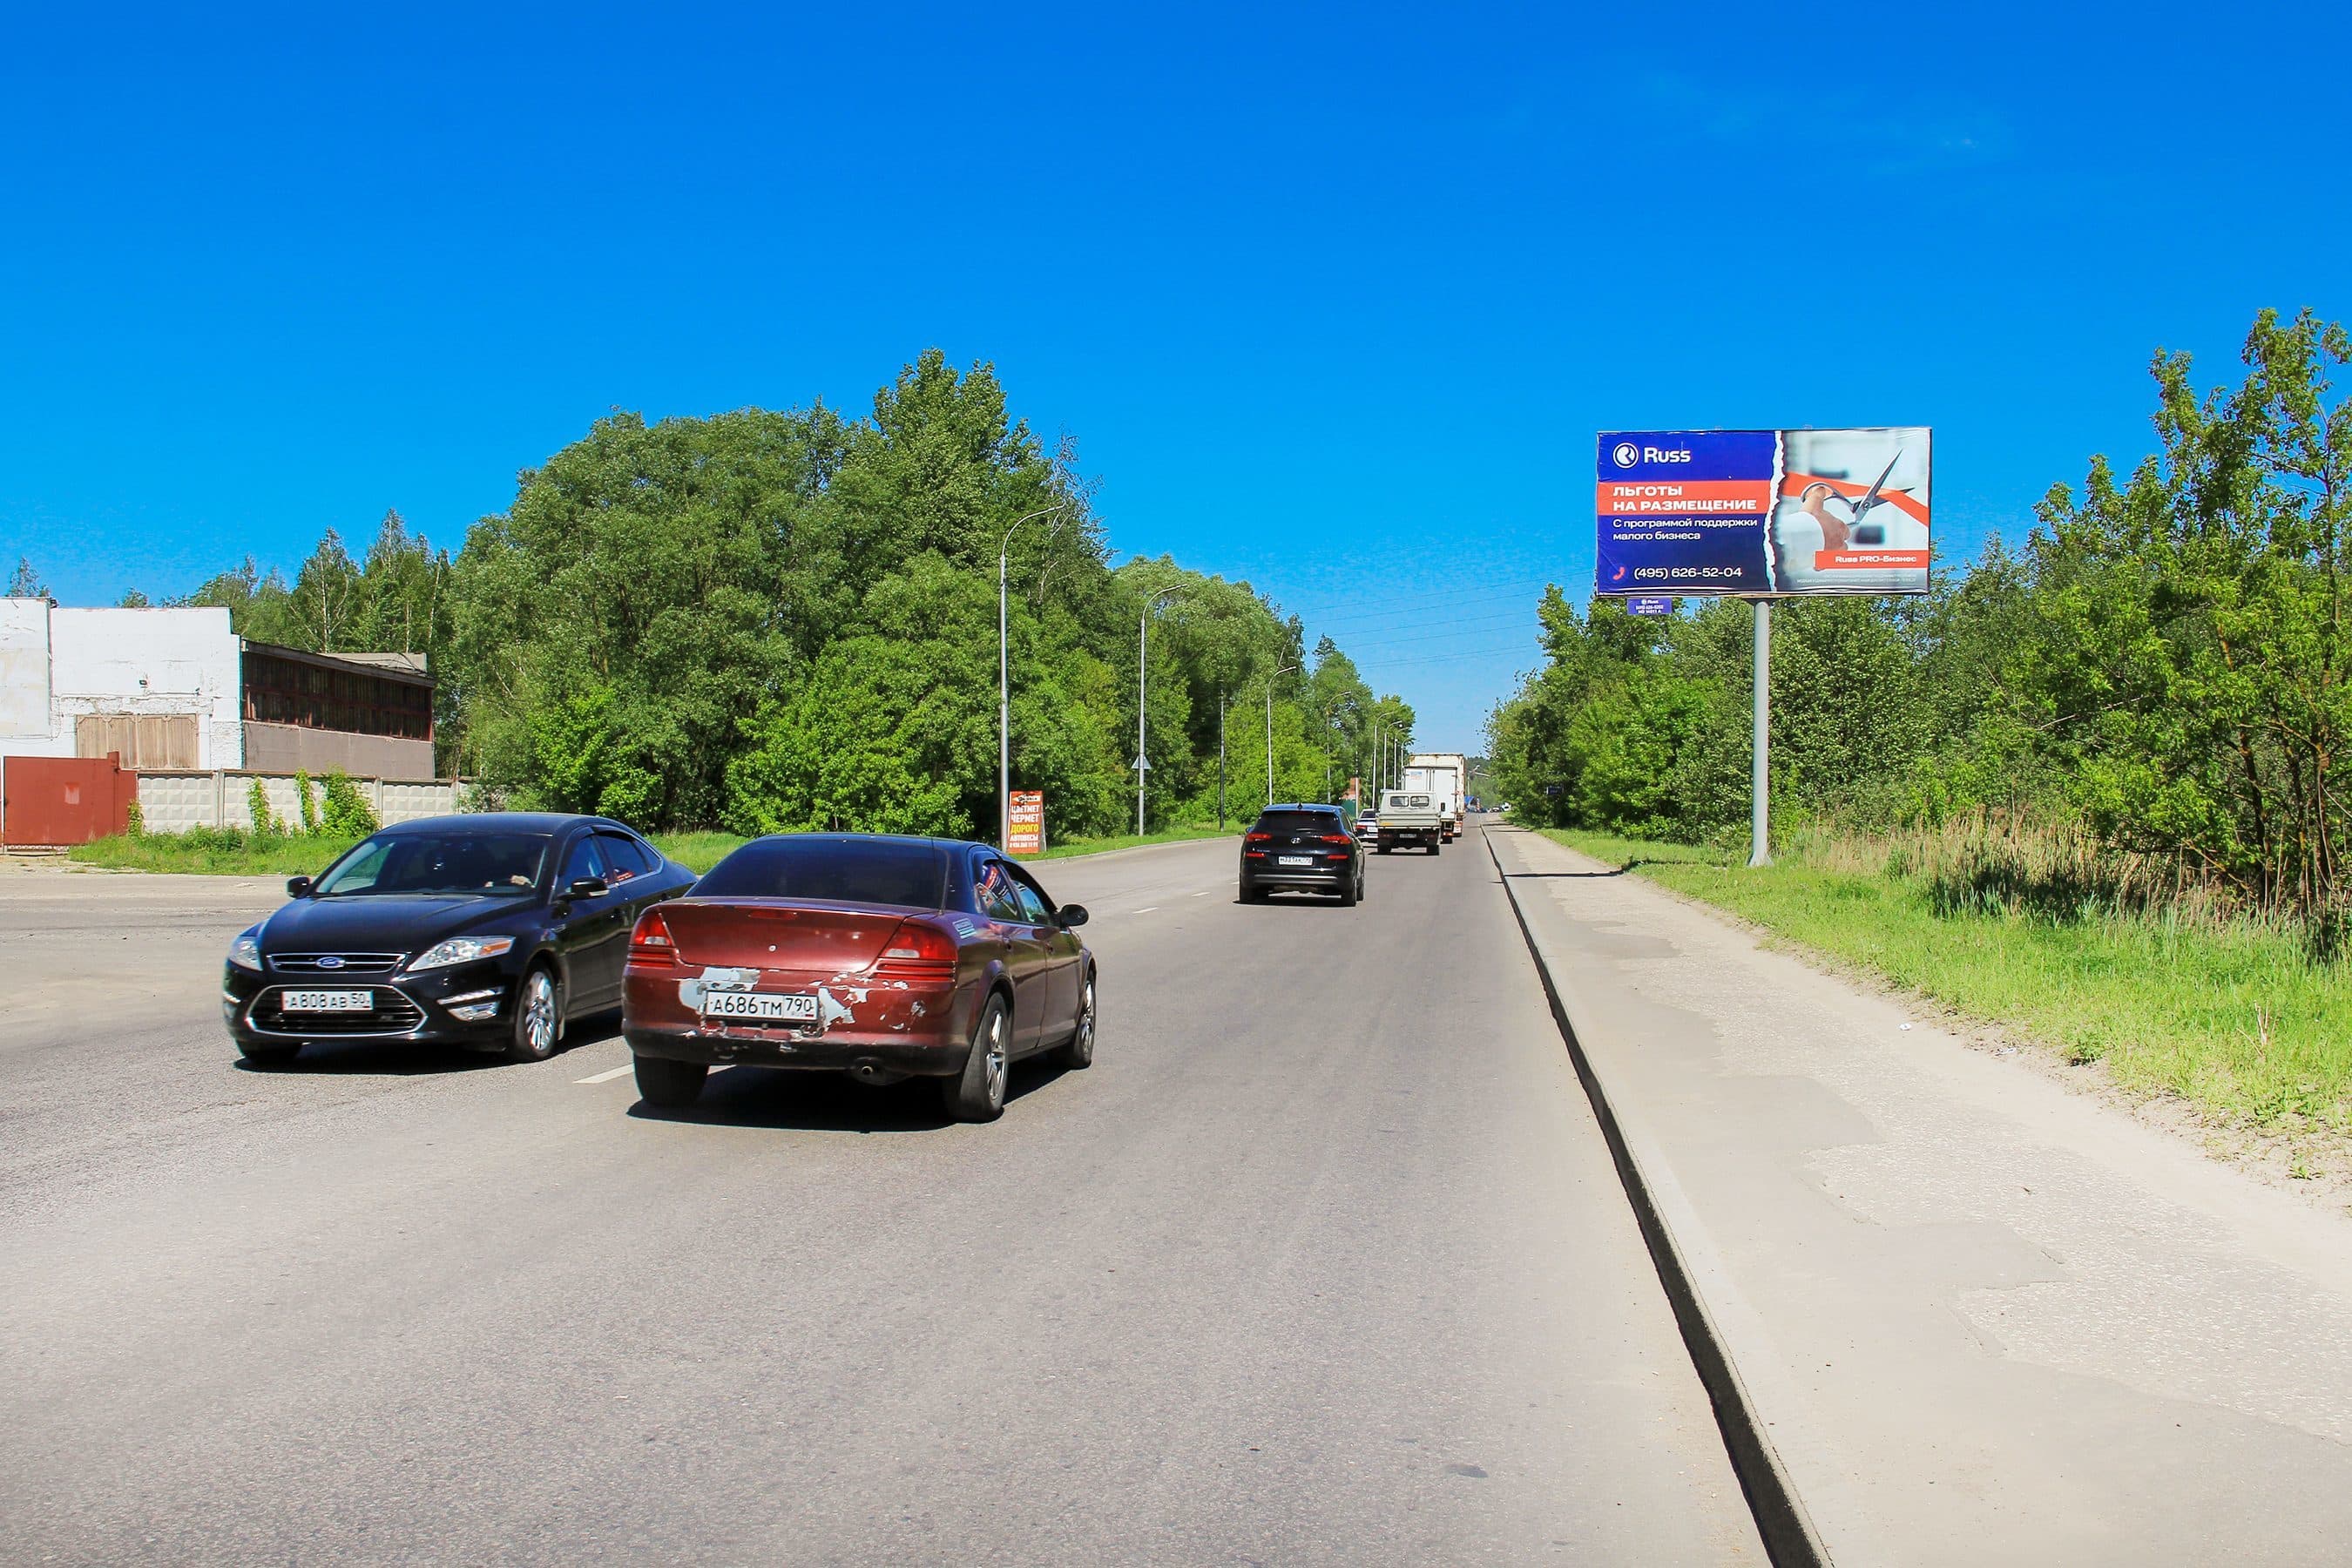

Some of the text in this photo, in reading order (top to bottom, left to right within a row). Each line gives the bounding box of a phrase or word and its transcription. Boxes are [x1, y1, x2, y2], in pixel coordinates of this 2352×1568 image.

[1644, 447, 1691, 463] Russ
[1612, 485, 1682, 497] ЛЬГОТЫ
[1613, 499, 1757, 512] НА РАЗМЕЩЕНИЕ
[1613, 517, 1758, 531] С программой поддержки
[1613, 531, 1701, 541] малого бизнеса
[1634, 567, 1742, 580] (495) 626-52-04
[1011, 814, 1039, 822] ЧЕРМЕТ
[1010, 824, 1038, 834] ДОРОГО
[291, 994, 347, 1007] А808АВ
[713, 996, 811, 1016] А686ТМ 790
